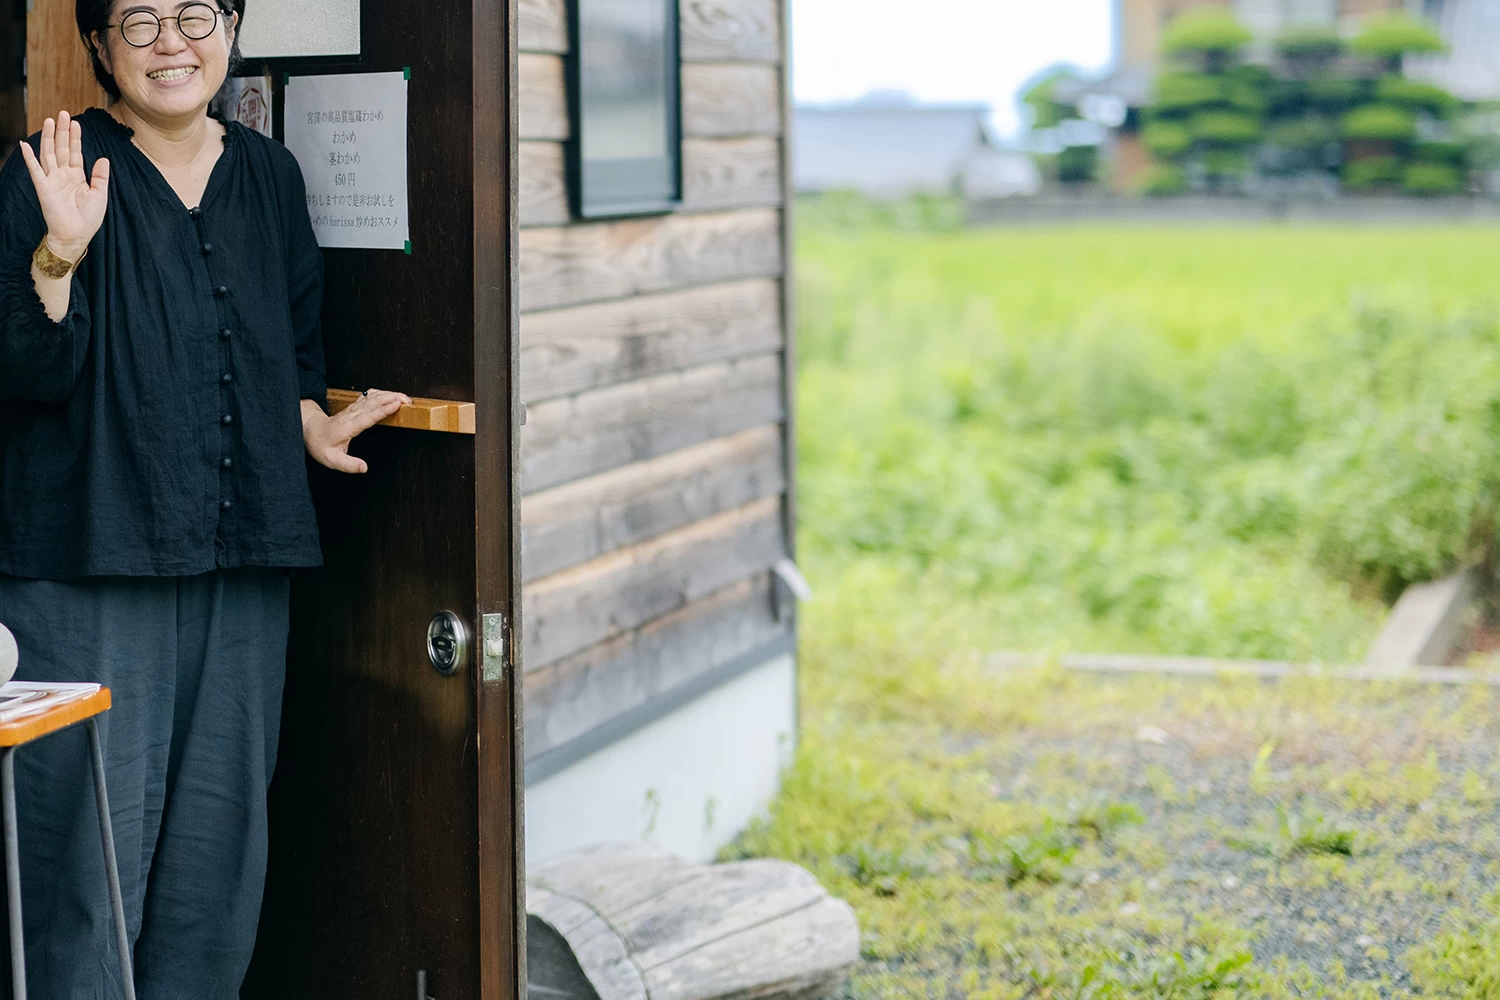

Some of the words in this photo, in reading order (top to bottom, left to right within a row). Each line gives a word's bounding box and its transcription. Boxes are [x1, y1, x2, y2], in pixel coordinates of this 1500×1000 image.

[332, 130, 357, 144] わかめ
[328, 151, 361, 166] 茎わかめ
